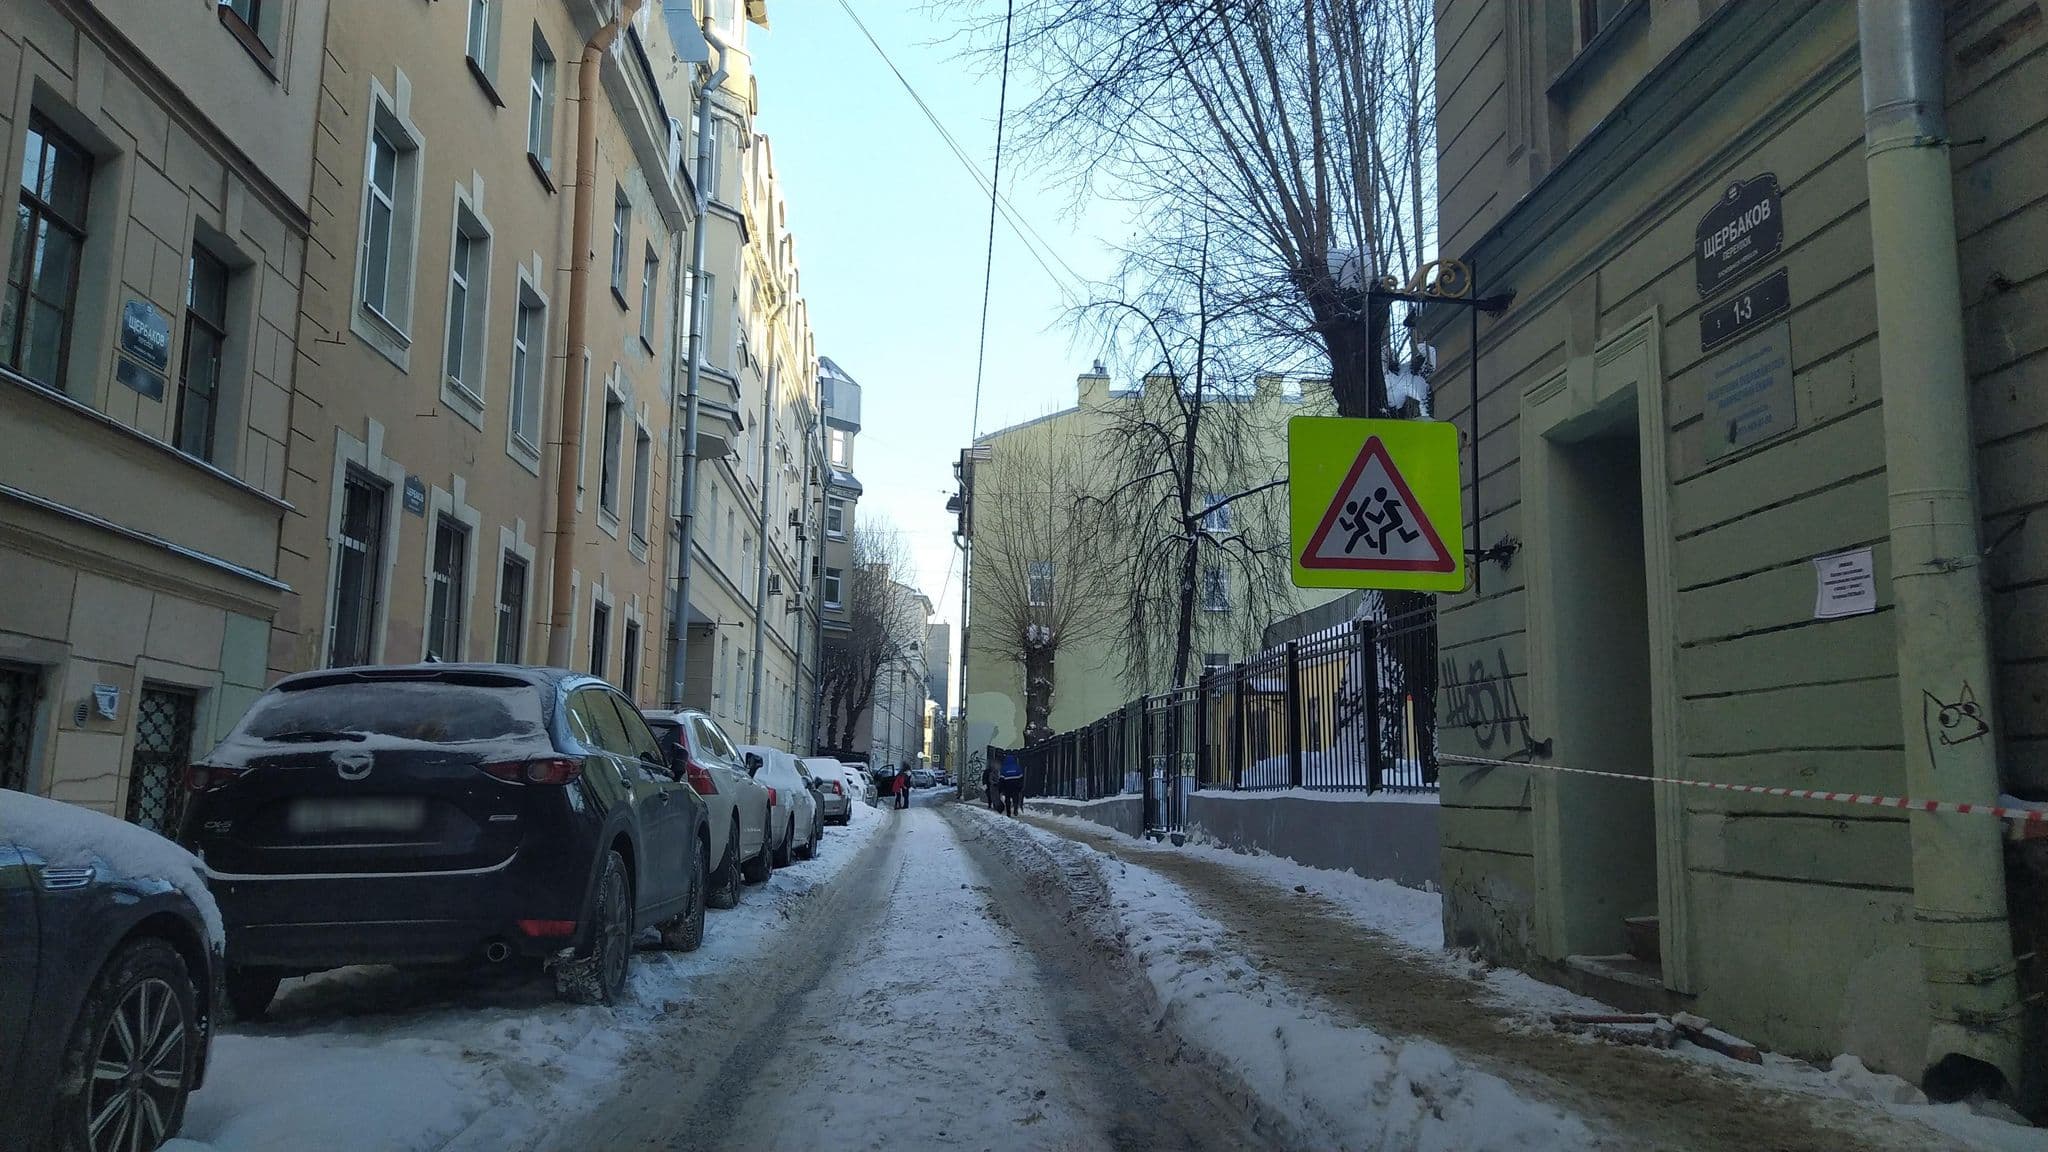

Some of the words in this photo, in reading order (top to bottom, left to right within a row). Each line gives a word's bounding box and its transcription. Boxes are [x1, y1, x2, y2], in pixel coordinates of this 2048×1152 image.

[1703, 198, 1771, 260] ЩЕРБАКОВ
[1733, 296, 1752, 324] 1-3
[128, 315, 165, 347] ЩЕРБАКОВ
